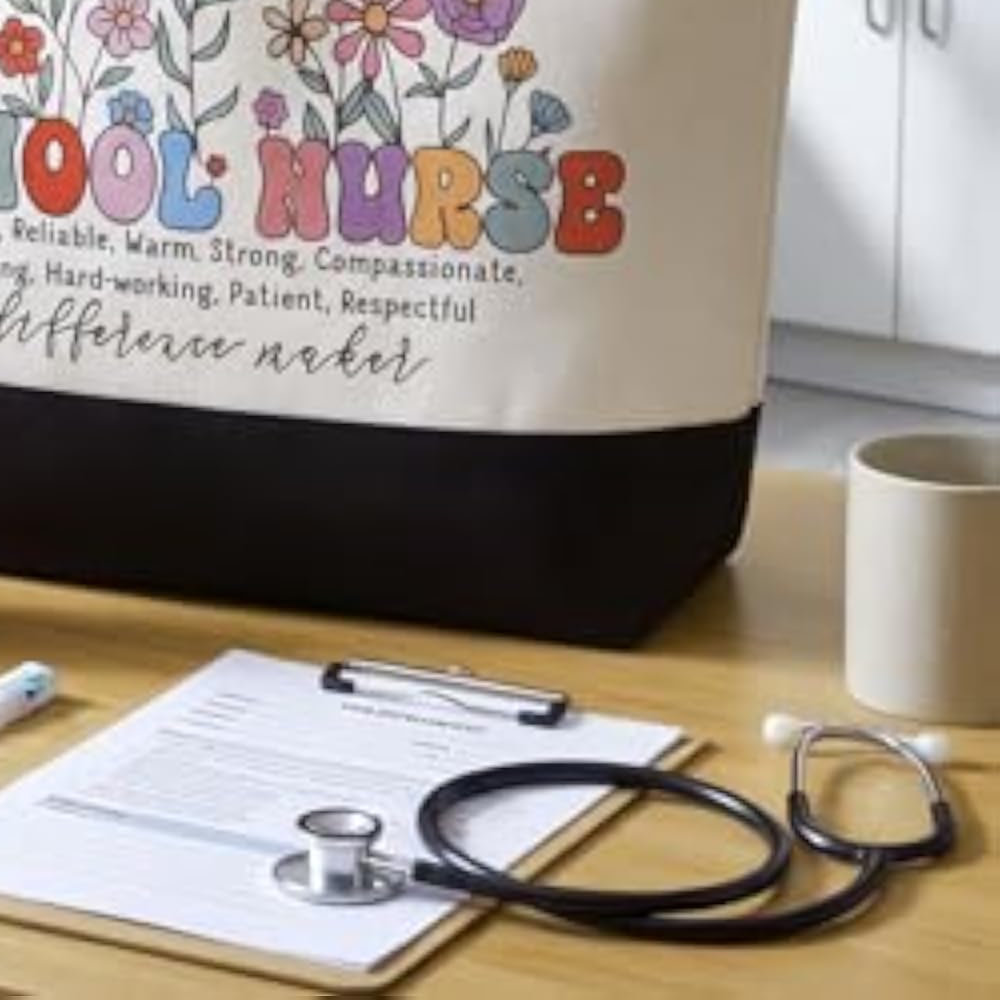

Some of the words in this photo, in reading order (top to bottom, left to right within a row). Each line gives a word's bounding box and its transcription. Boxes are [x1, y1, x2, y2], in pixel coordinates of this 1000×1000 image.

[256, 137, 626, 254] NURSE
[13, 218, 116, 254] Reliable,
[314, 247, 524, 287] Compassionate,
[45, 264, 220, 310] Hard-working,
[229, 281, 331, 316] Patient,
[341, 289, 475, 324] Respectful
